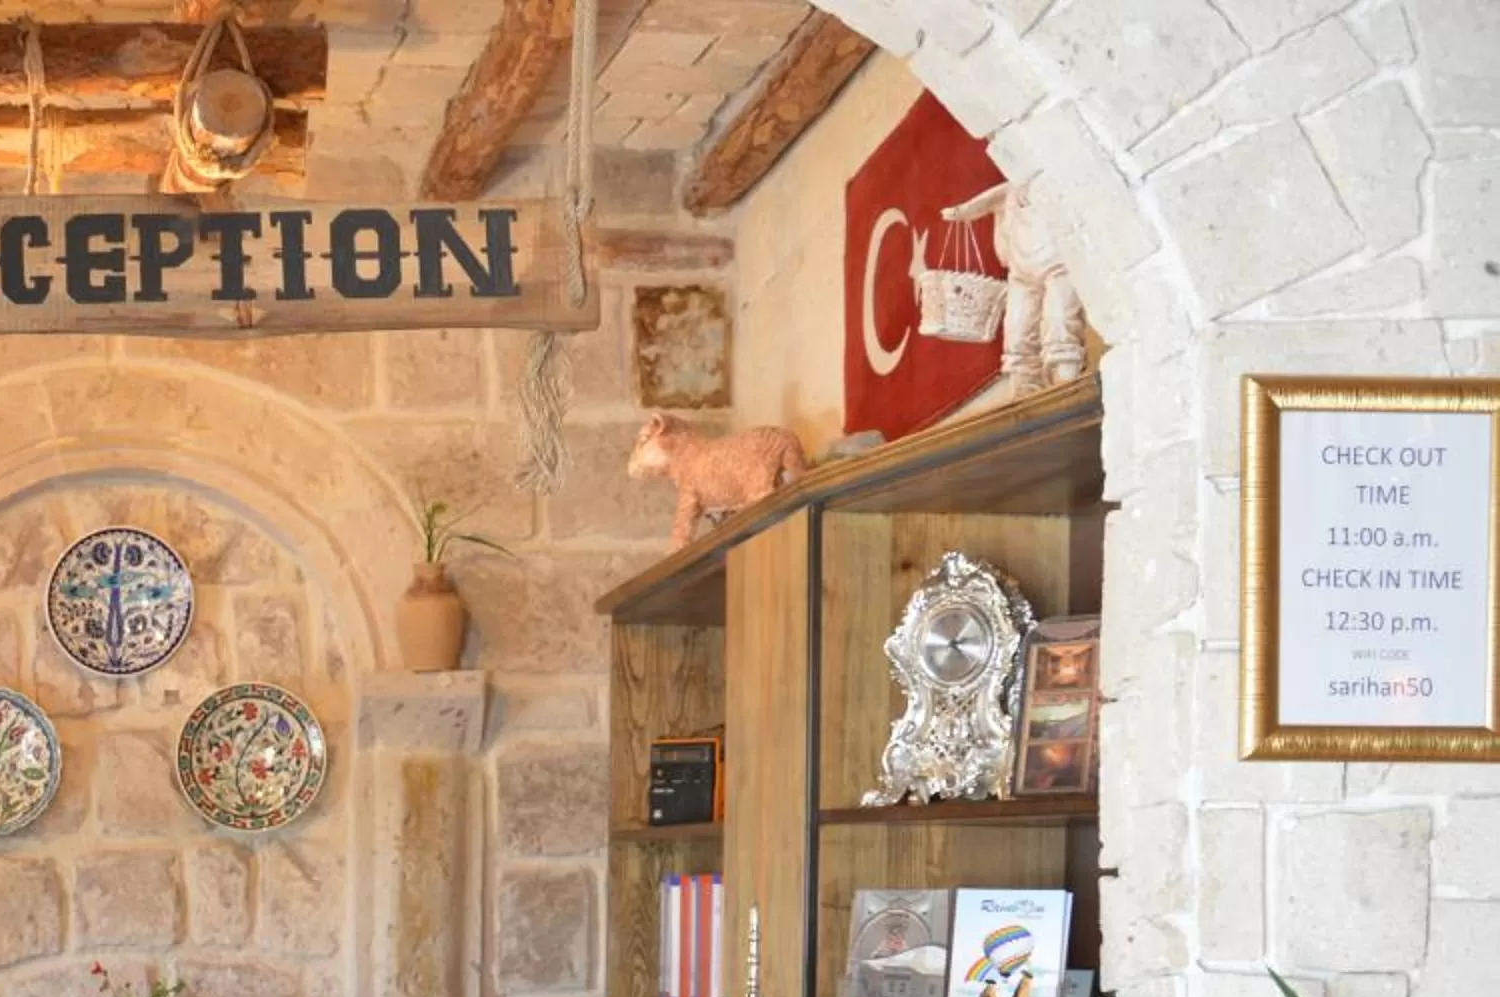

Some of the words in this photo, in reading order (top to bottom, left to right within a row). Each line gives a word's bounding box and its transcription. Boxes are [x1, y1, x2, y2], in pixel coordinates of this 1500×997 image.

[1321, 445, 1393, 466] CHECK
[1398, 447, 1447, 467] OUT
[1356, 485, 1411, 505] TIME
[1327, 526, 1387, 548] 11:00
[1393, 531, 1439, 548] a.m.
[1301, 568, 1373, 589] CHECK
[1378, 569, 1401, 590] IN
[1407, 569, 1462, 591] TIME
[1326, 611, 1385, 632] 12:30
[1390, 616, 1439, 635] p.m.
[1327, 676, 1433, 698] sarihan50
